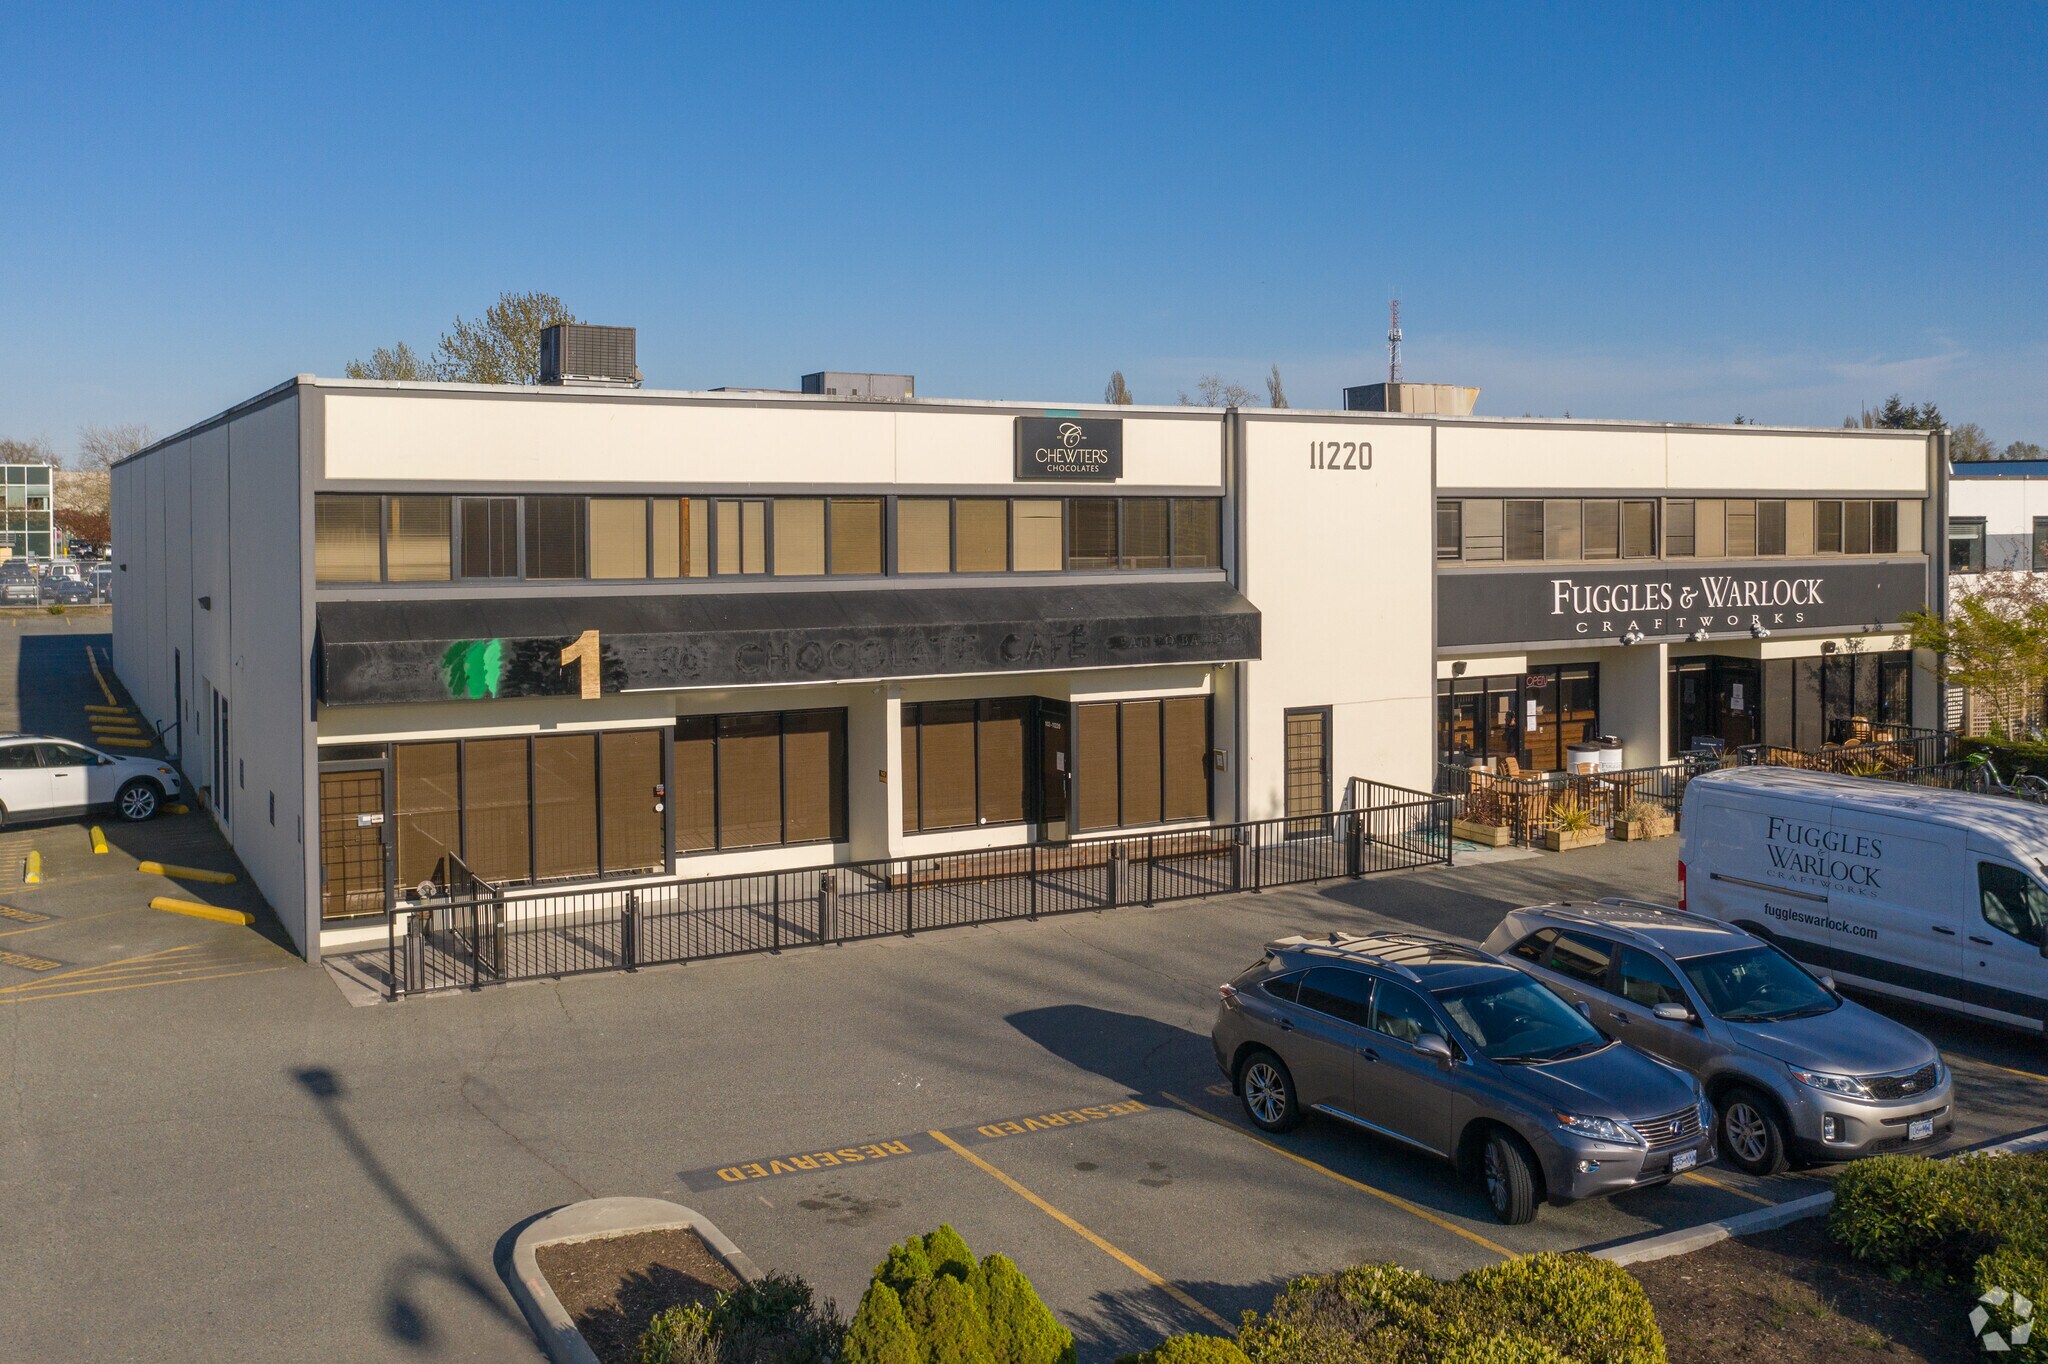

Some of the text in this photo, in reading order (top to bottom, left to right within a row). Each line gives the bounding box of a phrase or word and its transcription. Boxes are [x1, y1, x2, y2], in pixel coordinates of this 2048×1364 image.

[1046, 464, 1100, 473] CHOCOLATES
[1309, 441, 1372, 470] 11220
[1551, 576, 1825, 615] FUGGLES & WARLOCK
[1576, 612, 1805, 633] CRAFTWORKS
[1527, 675, 1548, 686] OPEN
[1766, 816, 1882, 859] FUGGLES
[1766, 844, 1882, 888] WARLOCK
[1766, 869, 1878, 898] CRAFTWORKS
[1764, 903, 1878, 940] fuggleswarlock.com
[977, 1100, 1150, 1138] RESERVED
[716, 1140, 912, 1182] RESERVED
